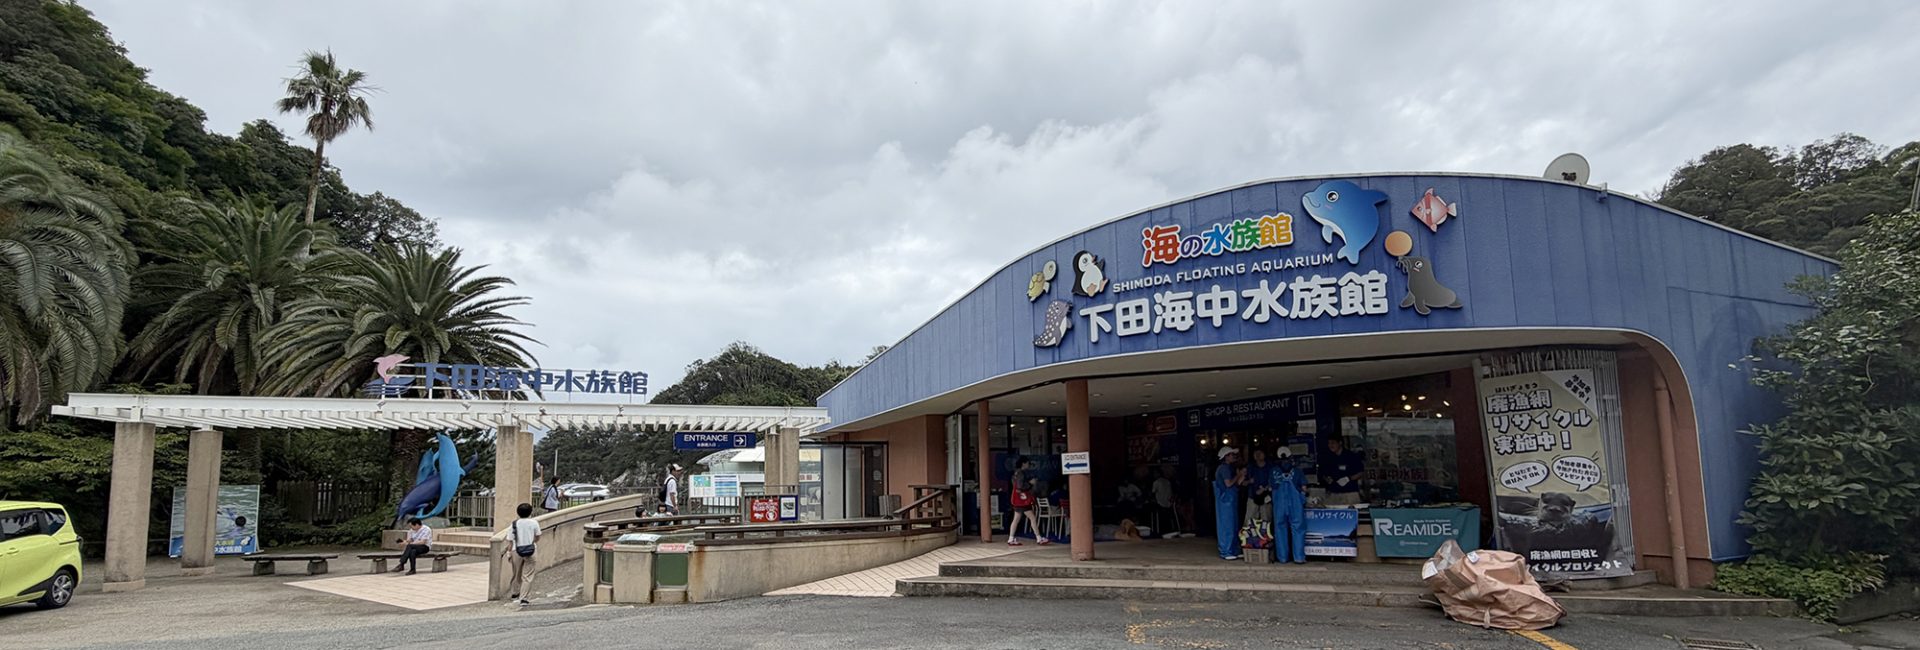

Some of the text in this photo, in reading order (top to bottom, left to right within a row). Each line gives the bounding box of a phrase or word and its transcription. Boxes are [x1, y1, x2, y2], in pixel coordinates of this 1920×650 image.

[1142, 212, 1294, 267] 海の水族館
[1112, 252, 1334, 293] SHIMODA FLOATING AQUARIUM
[1079, 269, 1389, 344] 下田海中水族館
[414, 361, 649, 395] 下田海中水族館
[1205, 407, 1225, 417] SHOP
[1233, 398, 1290, 413] RESTAURANT
[1486, 389, 1552, 413] 廃漁網
[1492, 408, 1593, 434] リサイクル
[684, 434, 728, 442] ENTRANCE
[1493, 430, 1573, 455] 実施中！
[1374, 518, 1452, 536] REAMIDE
[1530, 548, 1598, 560] 廃漁網の回収と
